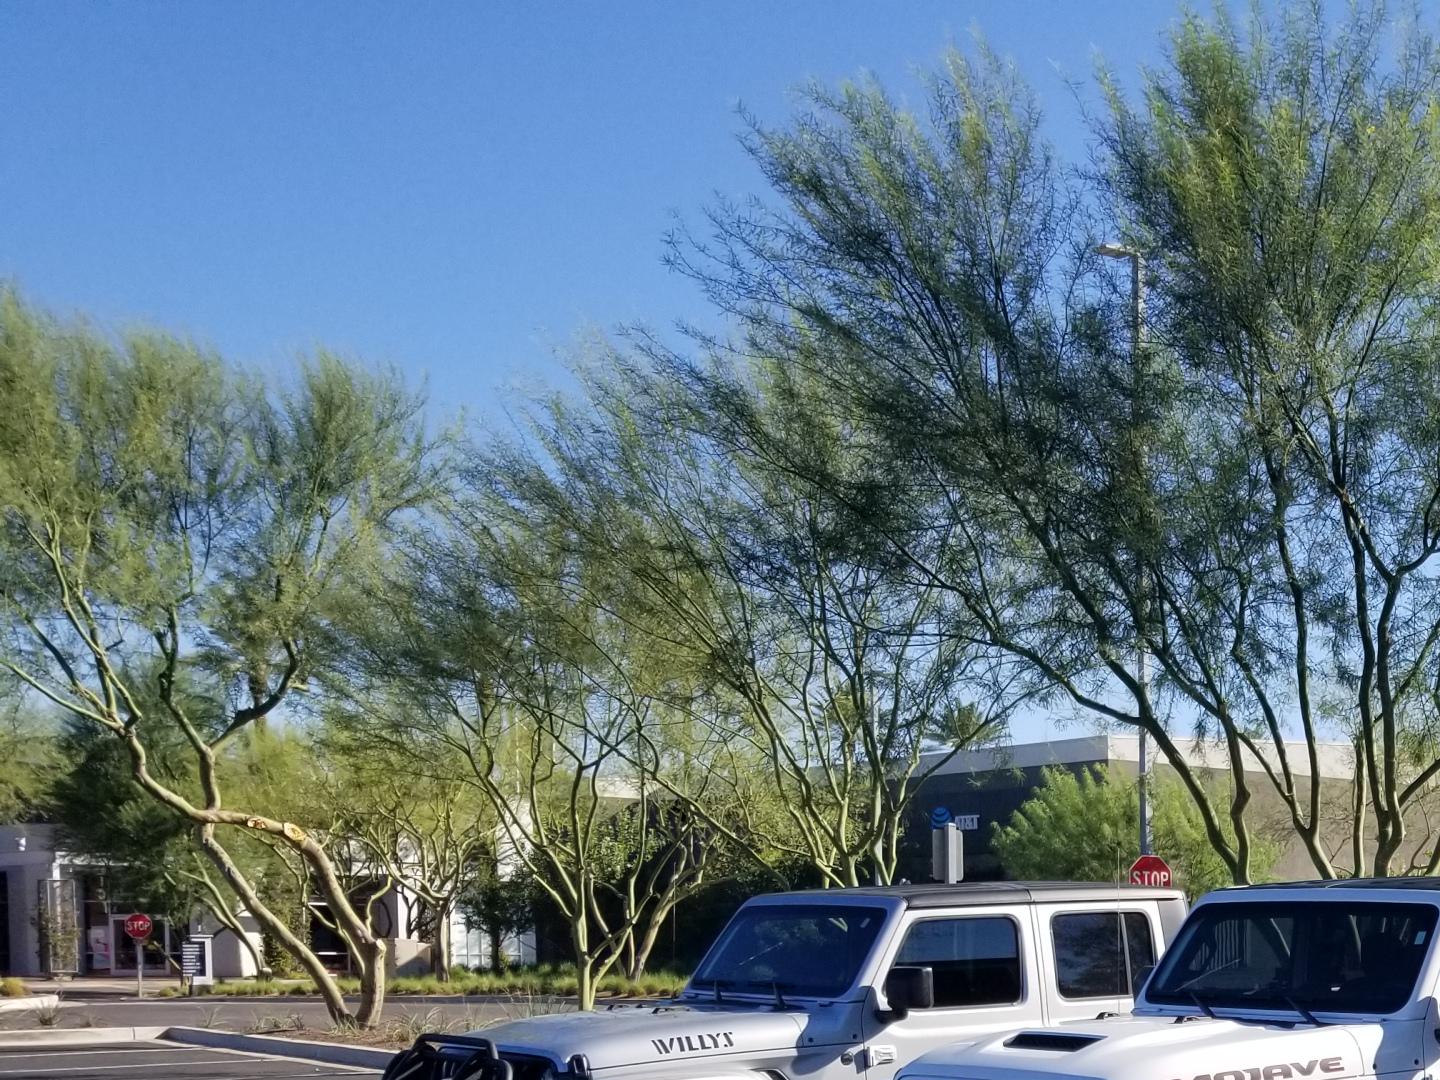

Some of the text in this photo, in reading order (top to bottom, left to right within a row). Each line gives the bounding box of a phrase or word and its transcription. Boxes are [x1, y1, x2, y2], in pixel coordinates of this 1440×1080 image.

[1132, 870, 1169, 887] STOP
[127, 921, 151, 931] STOP
[651, 1031, 734, 1055] WILLYS
